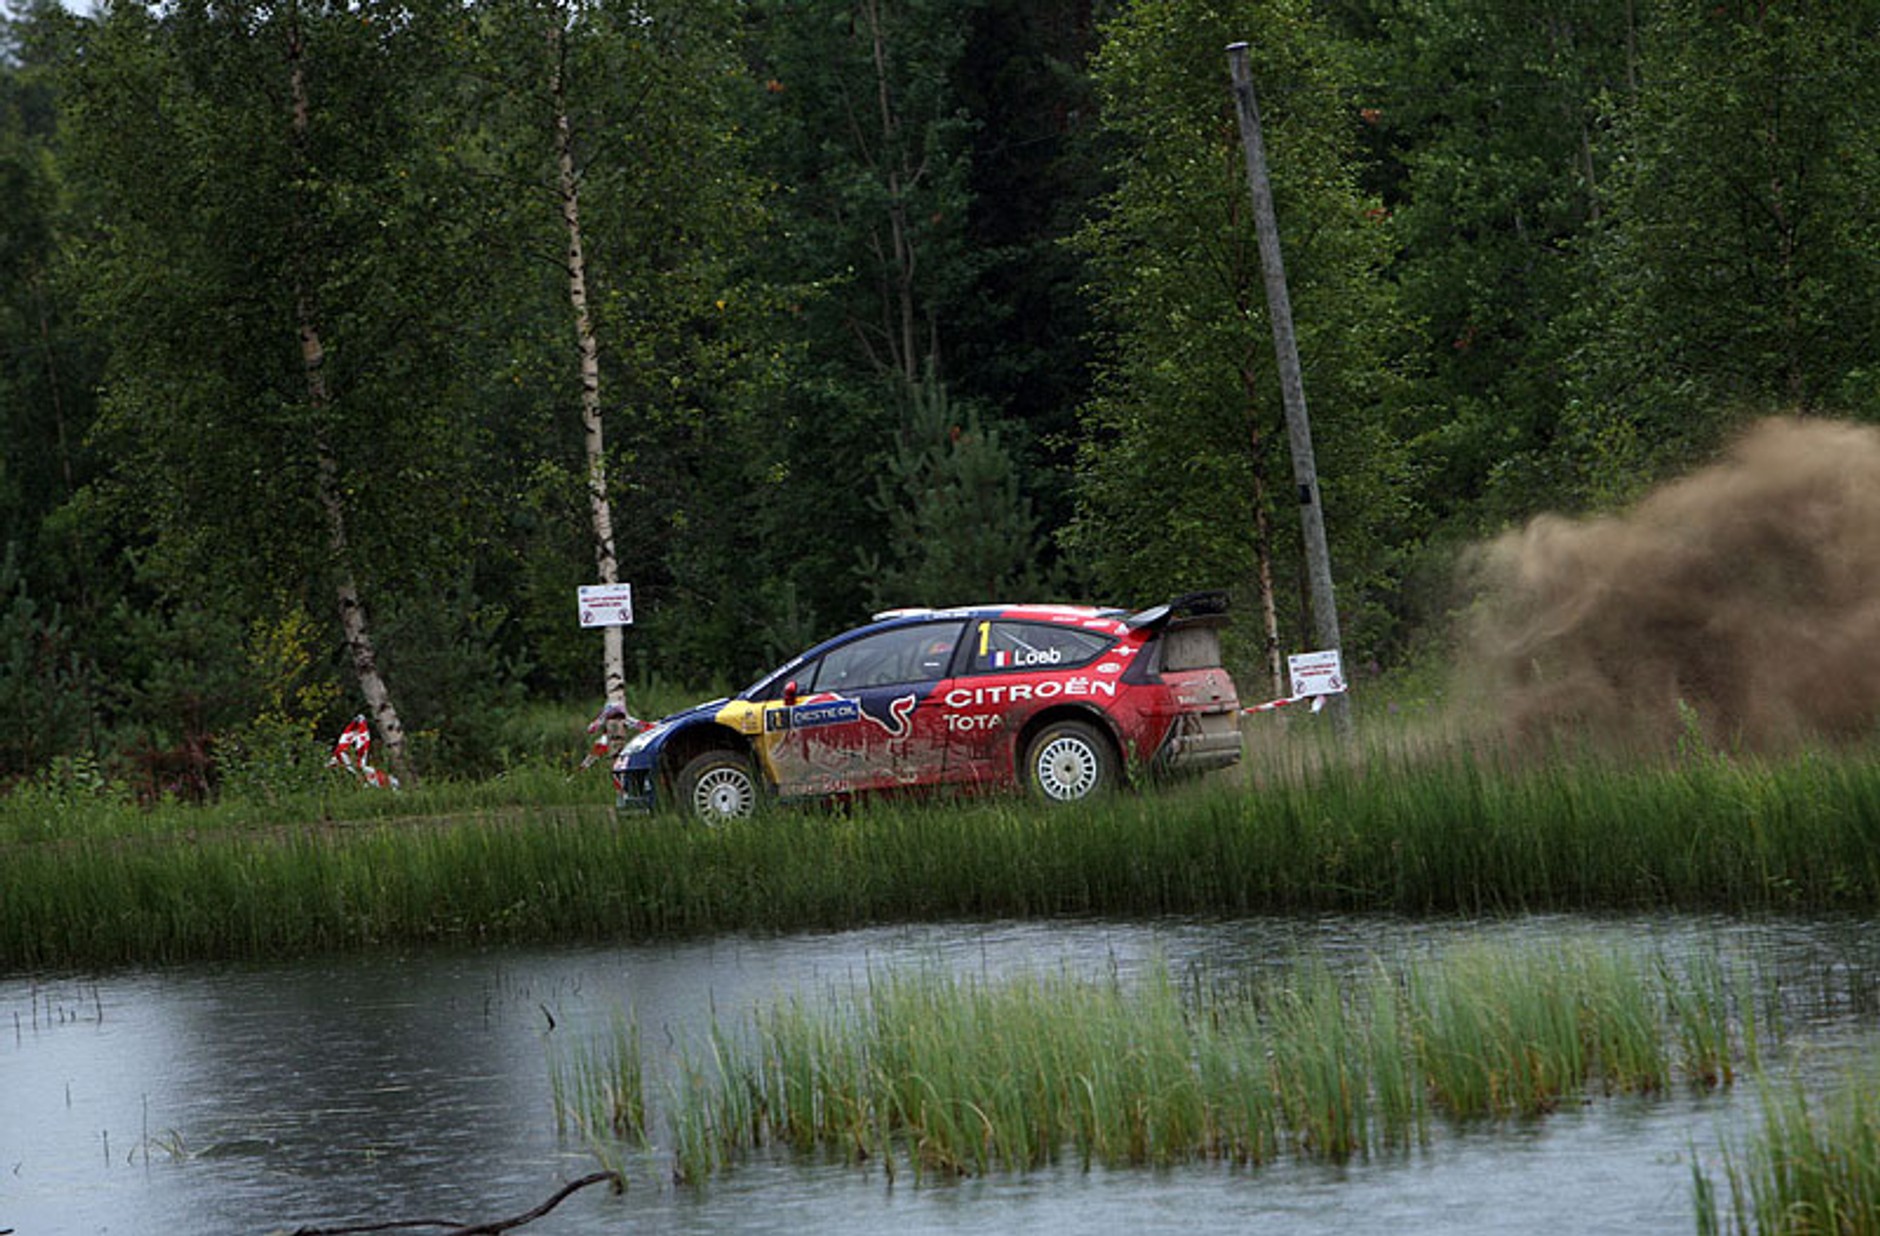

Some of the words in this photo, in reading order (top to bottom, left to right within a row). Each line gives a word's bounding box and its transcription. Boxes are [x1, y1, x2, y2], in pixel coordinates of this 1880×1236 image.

[977, 620, 991, 656] 1
[1014, 646, 1062, 665] Loeb
[944, 676, 1117, 708] CITROËN
[942, 714, 1004, 732] TOTA
